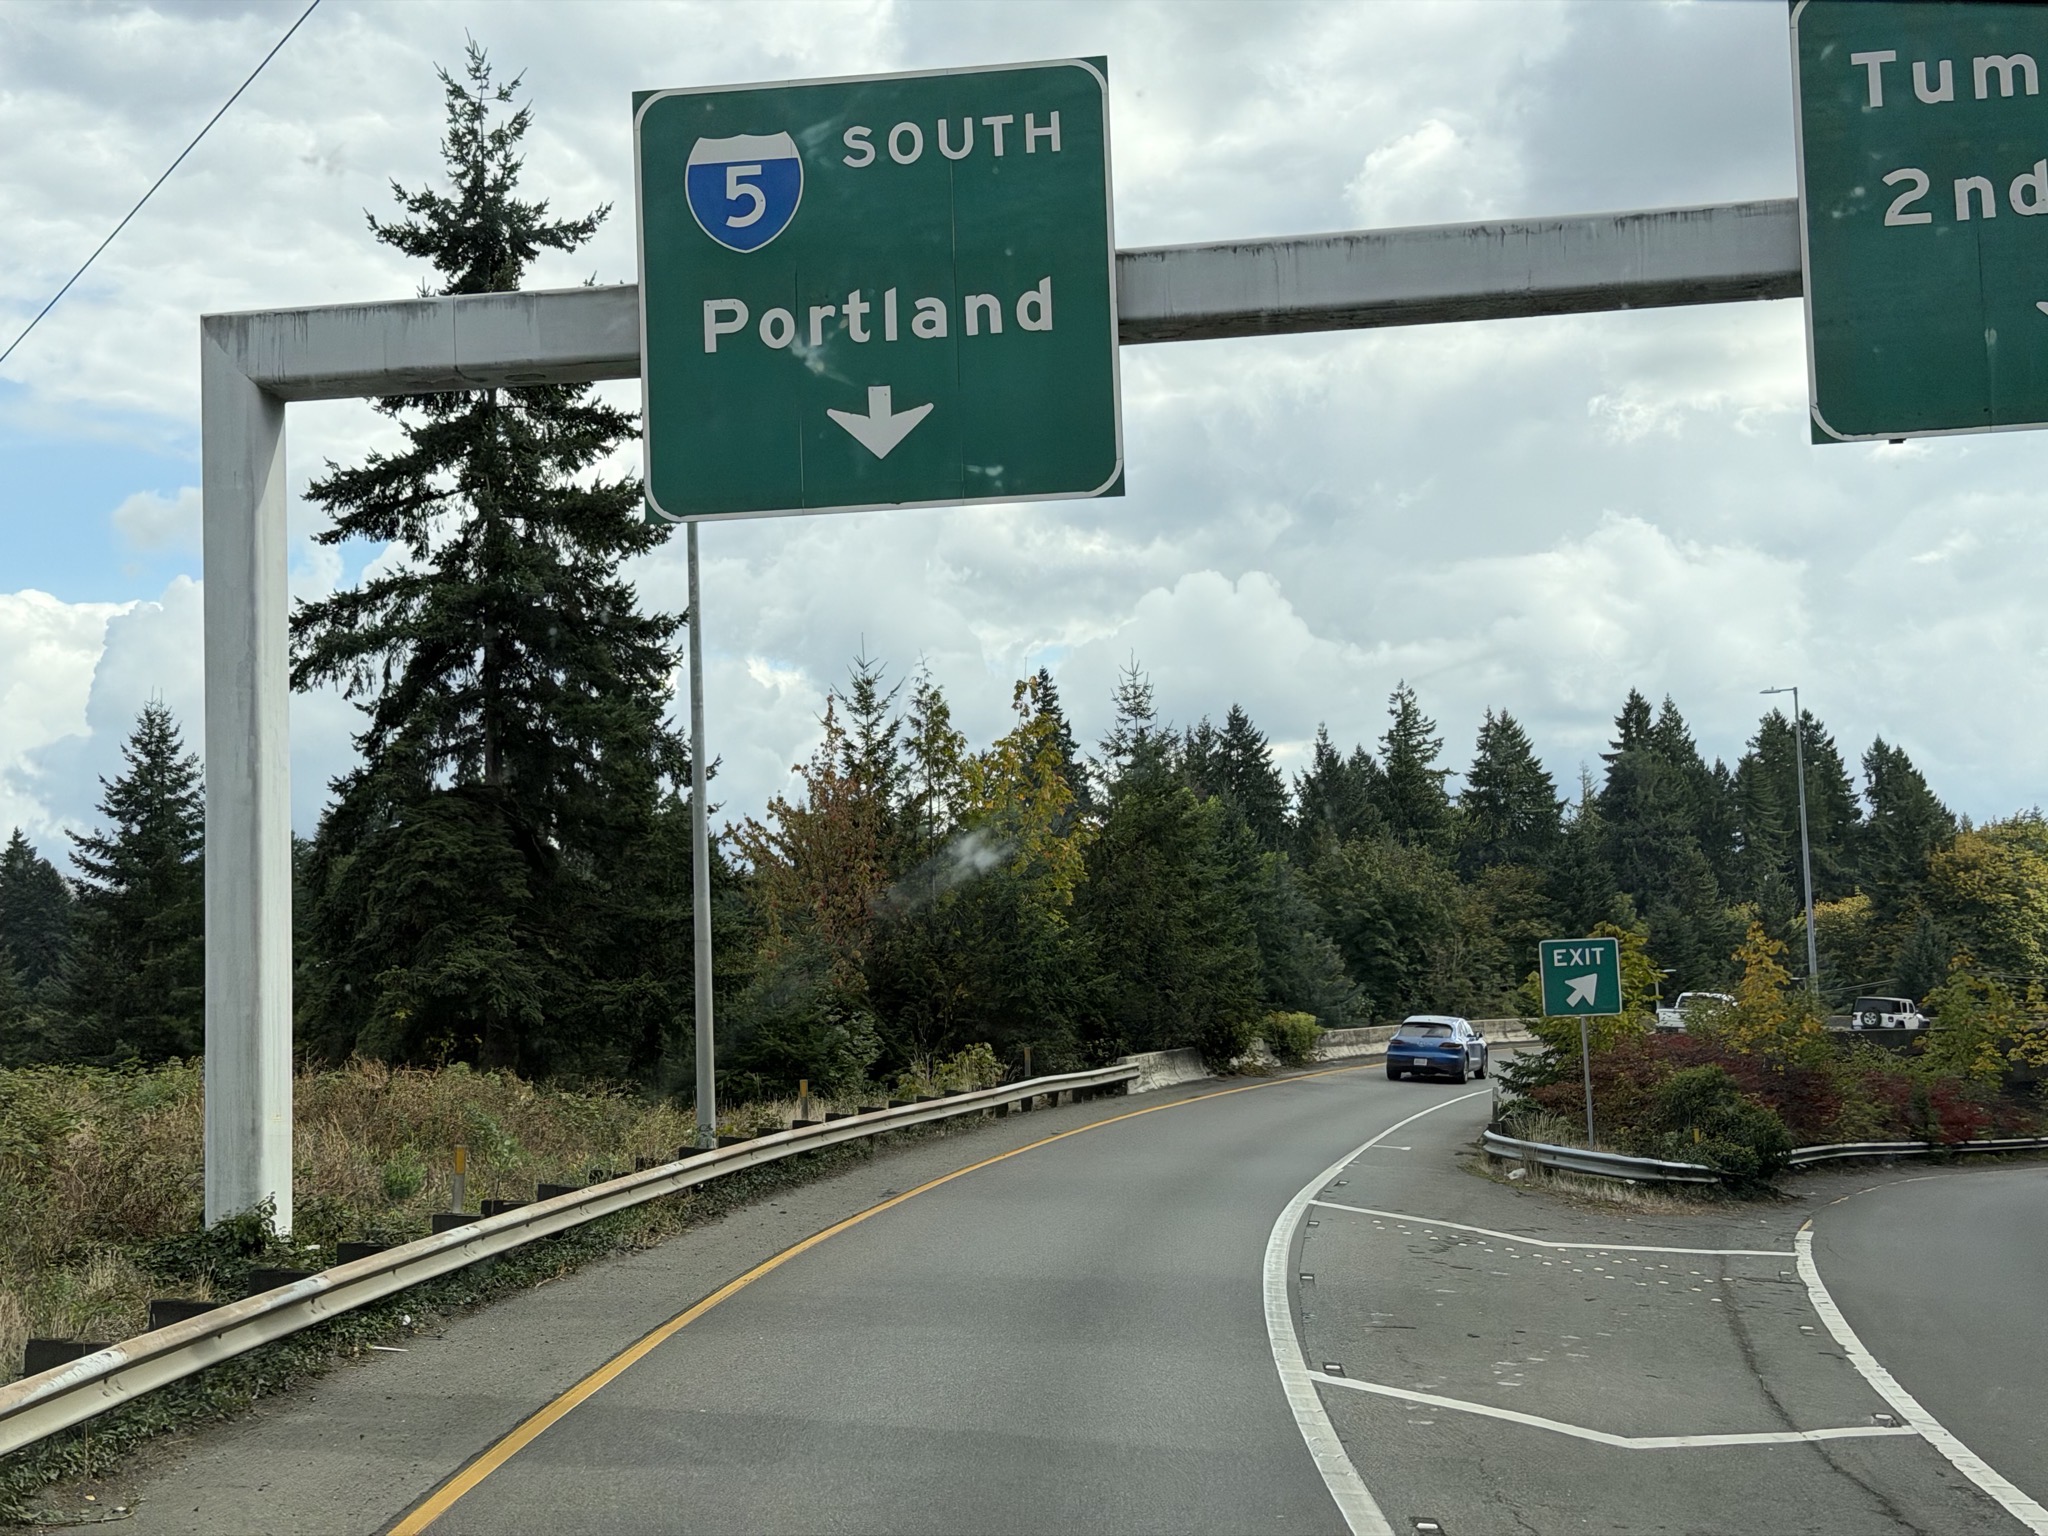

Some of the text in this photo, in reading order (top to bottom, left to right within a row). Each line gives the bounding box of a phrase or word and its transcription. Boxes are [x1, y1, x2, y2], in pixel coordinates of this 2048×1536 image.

[1850, 49, 2039, 108] Tum
[724, 110, 1061, 229] 5 SOUTH
[1881, 158, 2048, 227] 2nd
[703, 276, 1053, 354] Portland
[1553, 947, 1605, 967] EXIT
